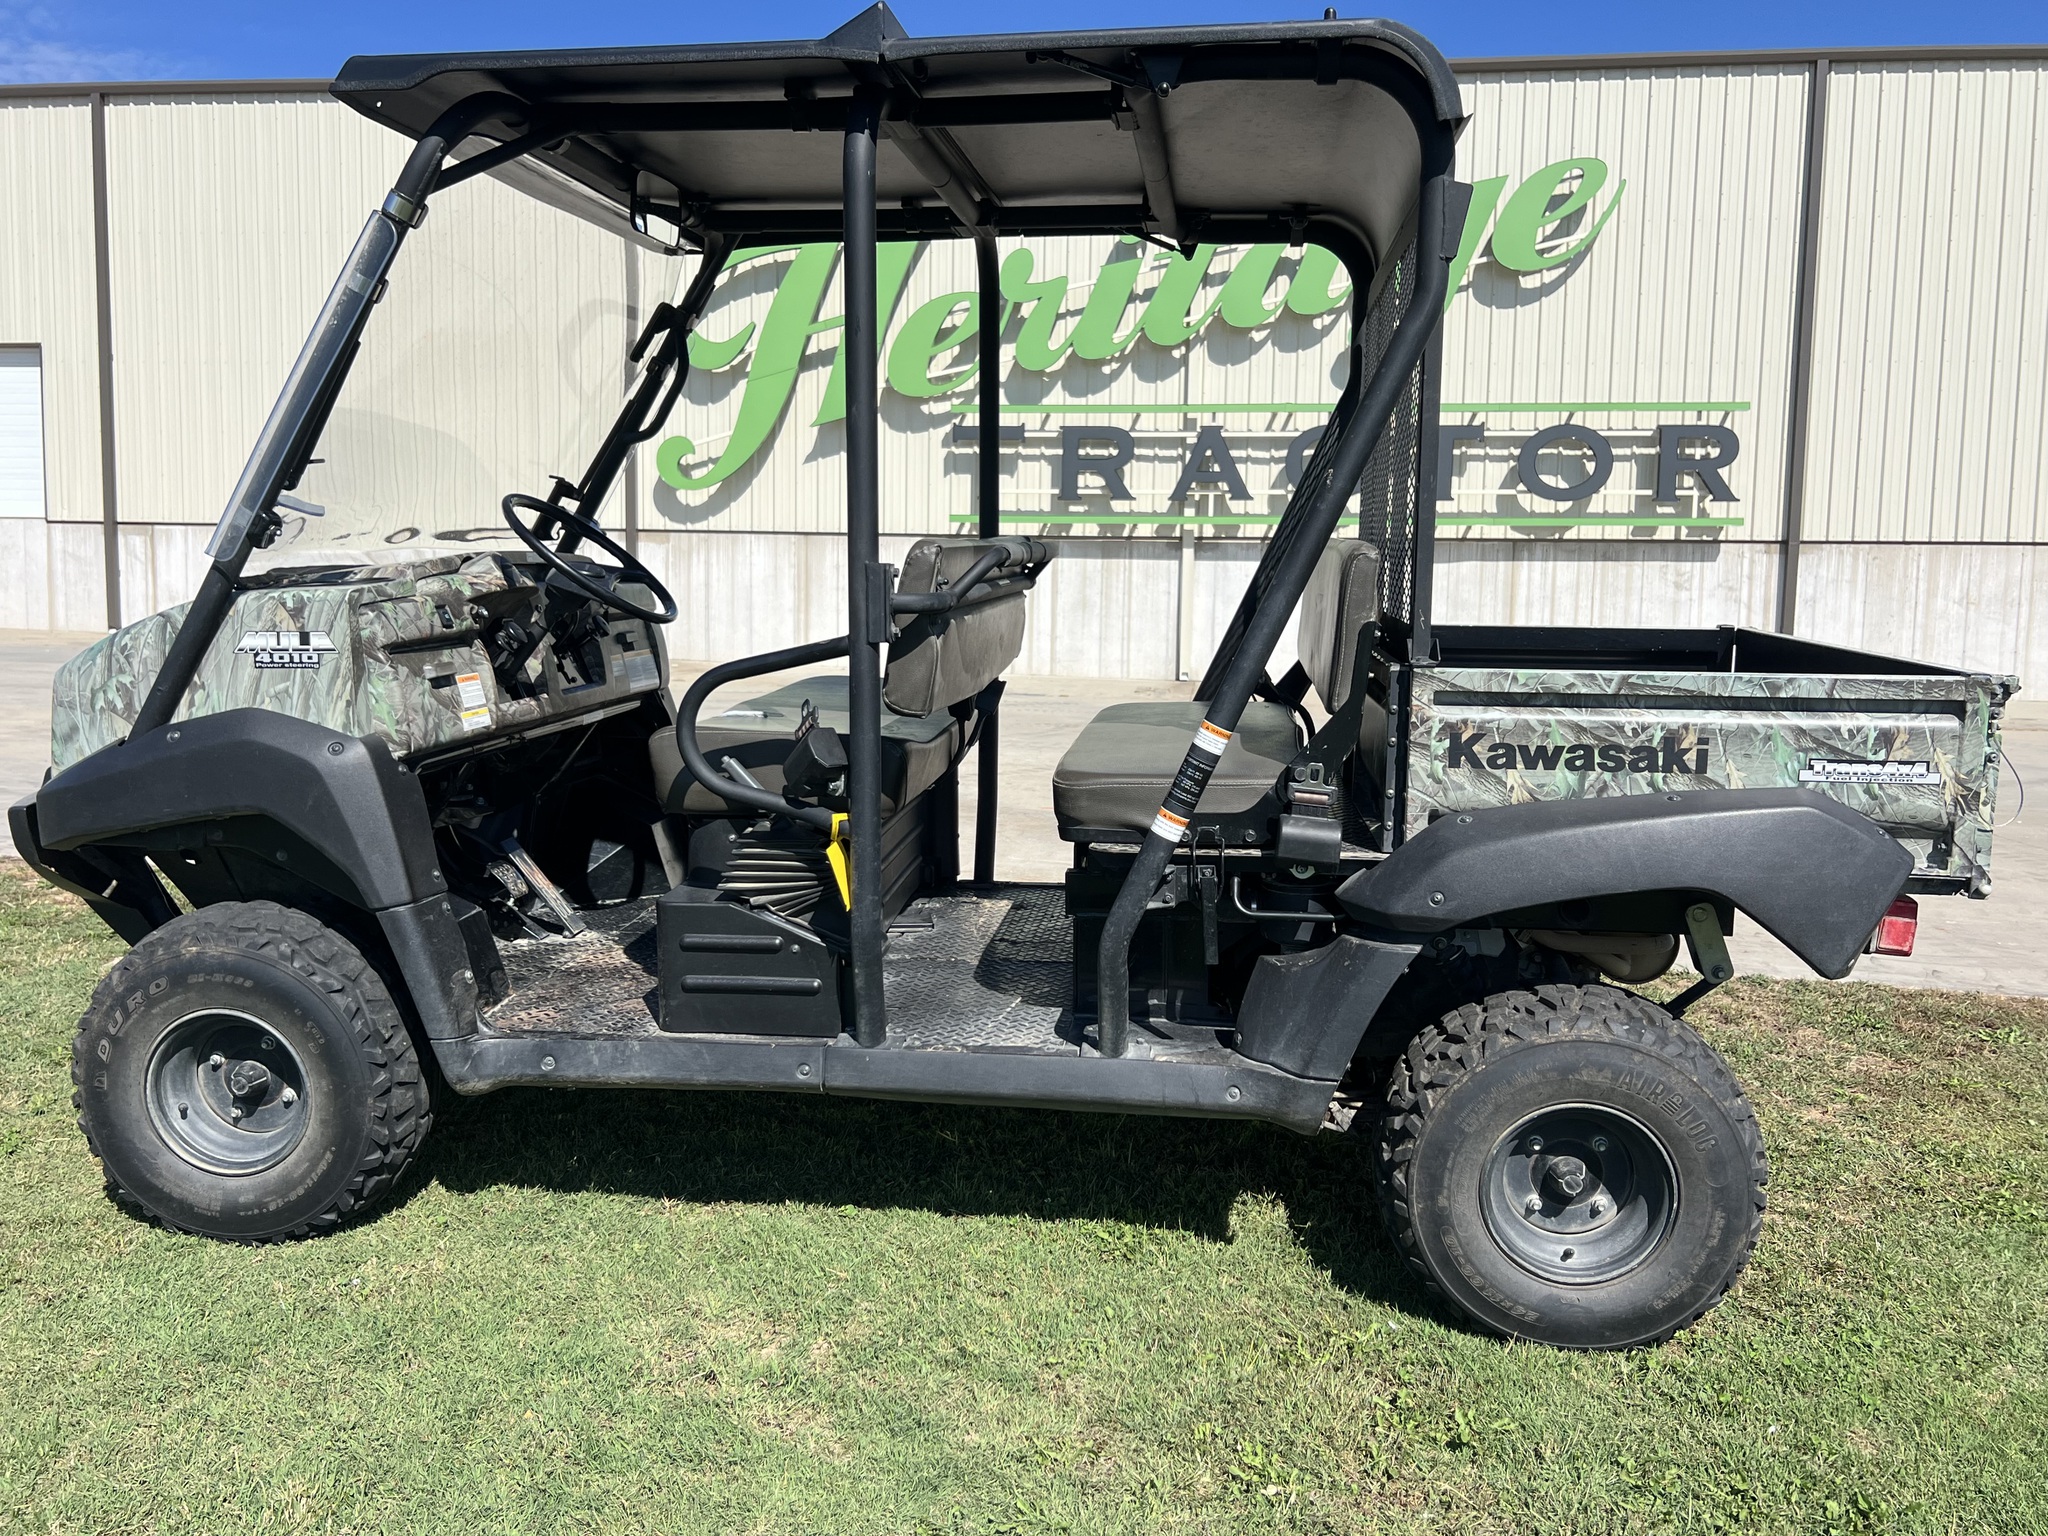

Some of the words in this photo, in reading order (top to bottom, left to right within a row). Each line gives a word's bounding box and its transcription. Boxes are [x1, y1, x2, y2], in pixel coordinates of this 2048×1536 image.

[233, 631, 340, 654] MULE
[255, 653, 319, 663] 4010
[1448, 733, 1709, 775] Kawasaki
[1811, 760, 1929, 778] Trans4x4
[97, 975, 169, 1063] DURO
